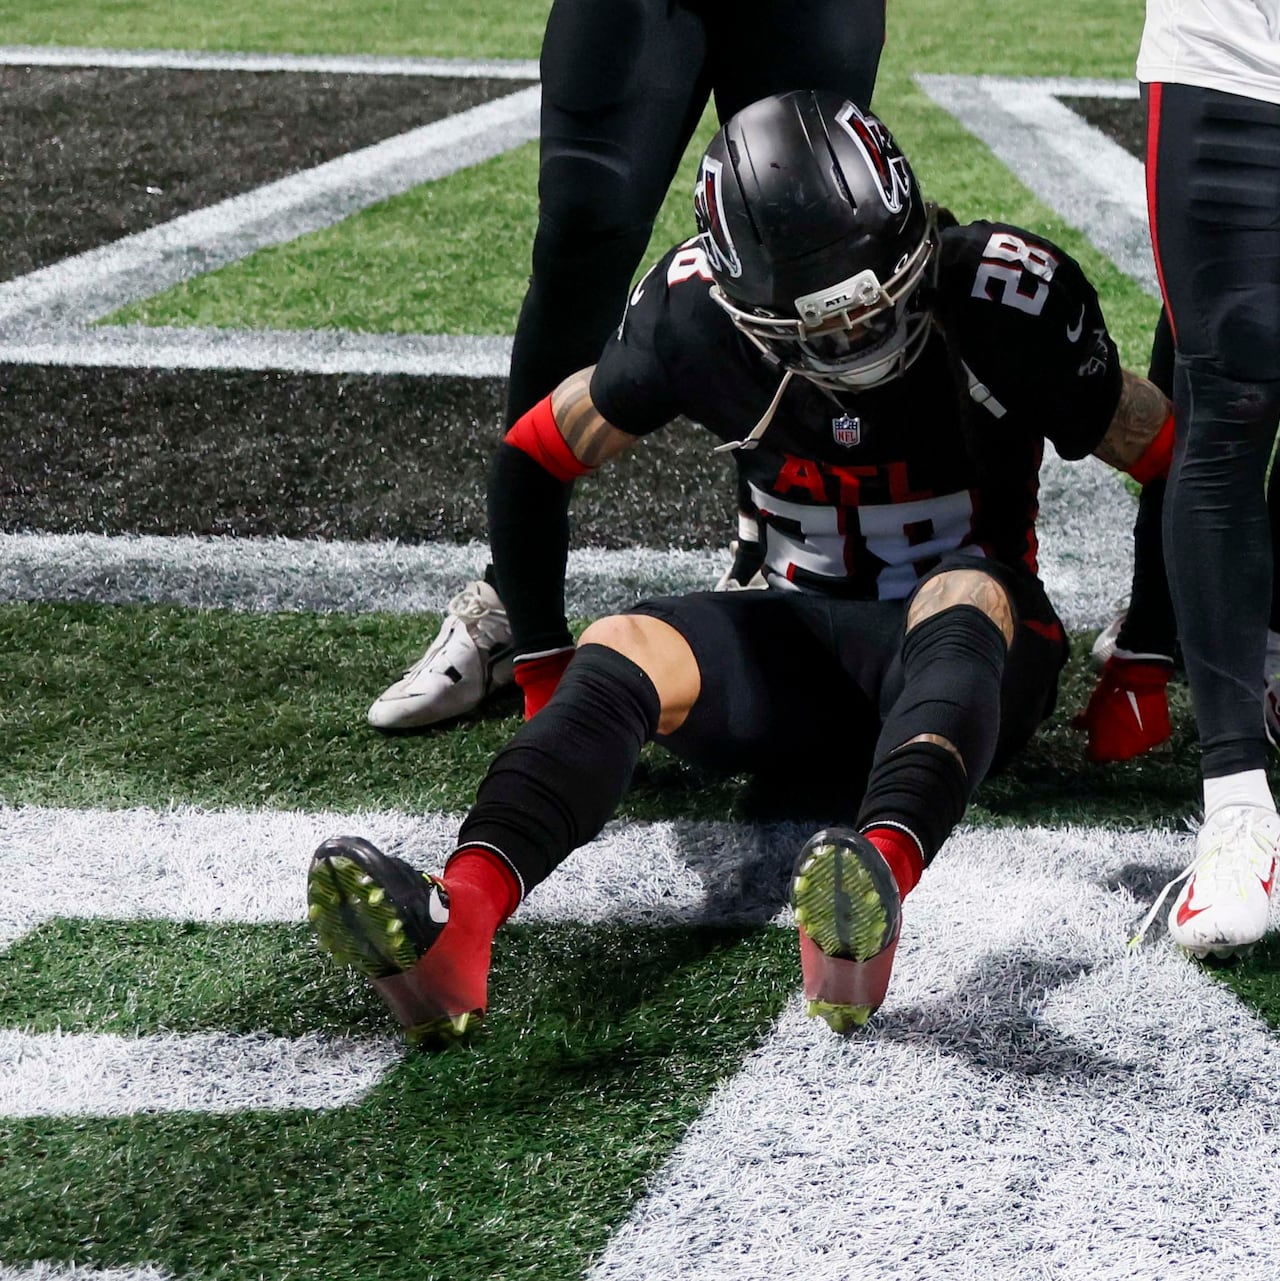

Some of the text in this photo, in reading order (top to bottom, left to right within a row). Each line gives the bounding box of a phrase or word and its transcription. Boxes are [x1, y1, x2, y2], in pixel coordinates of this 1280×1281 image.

[970, 232, 1058, 318] 28
[824, 294, 852, 309] ATL
[773, 453, 934, 505] ATL
